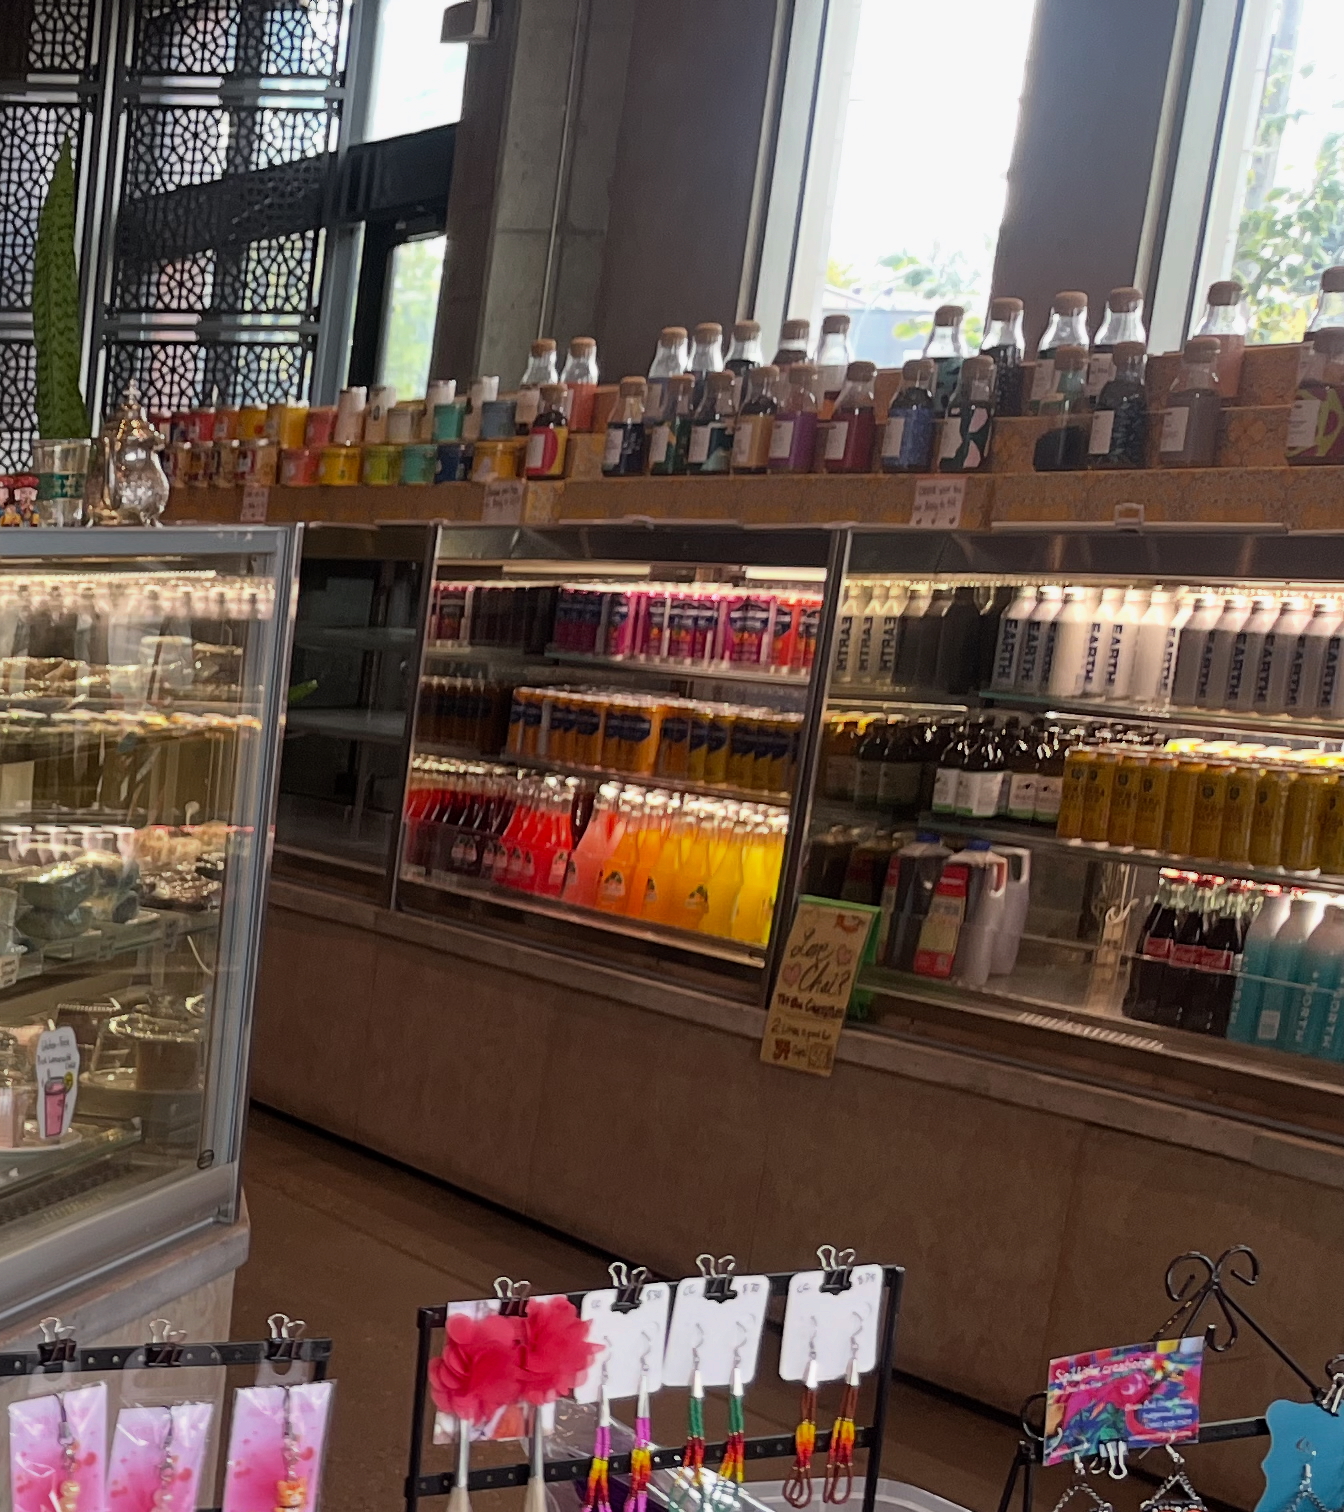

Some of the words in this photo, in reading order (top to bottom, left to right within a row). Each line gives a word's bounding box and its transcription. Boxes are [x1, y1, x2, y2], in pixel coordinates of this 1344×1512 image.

[998, 619, 1017, 678] EARTH
[1023, 622, 1040, 680] EARTH
[1084, 623, 1100, 682] EARTH
[1107, 625, 1122, 685] EARTH
[1160, 628, 1176, 692] EARTH
[1227, 633, 1246, 699] EARTH
[1254, 635, 1274, 702] EARTH
[1284, 636, 1304, 705] EARTH
[1317, 637, 1339, 707] EARTH
